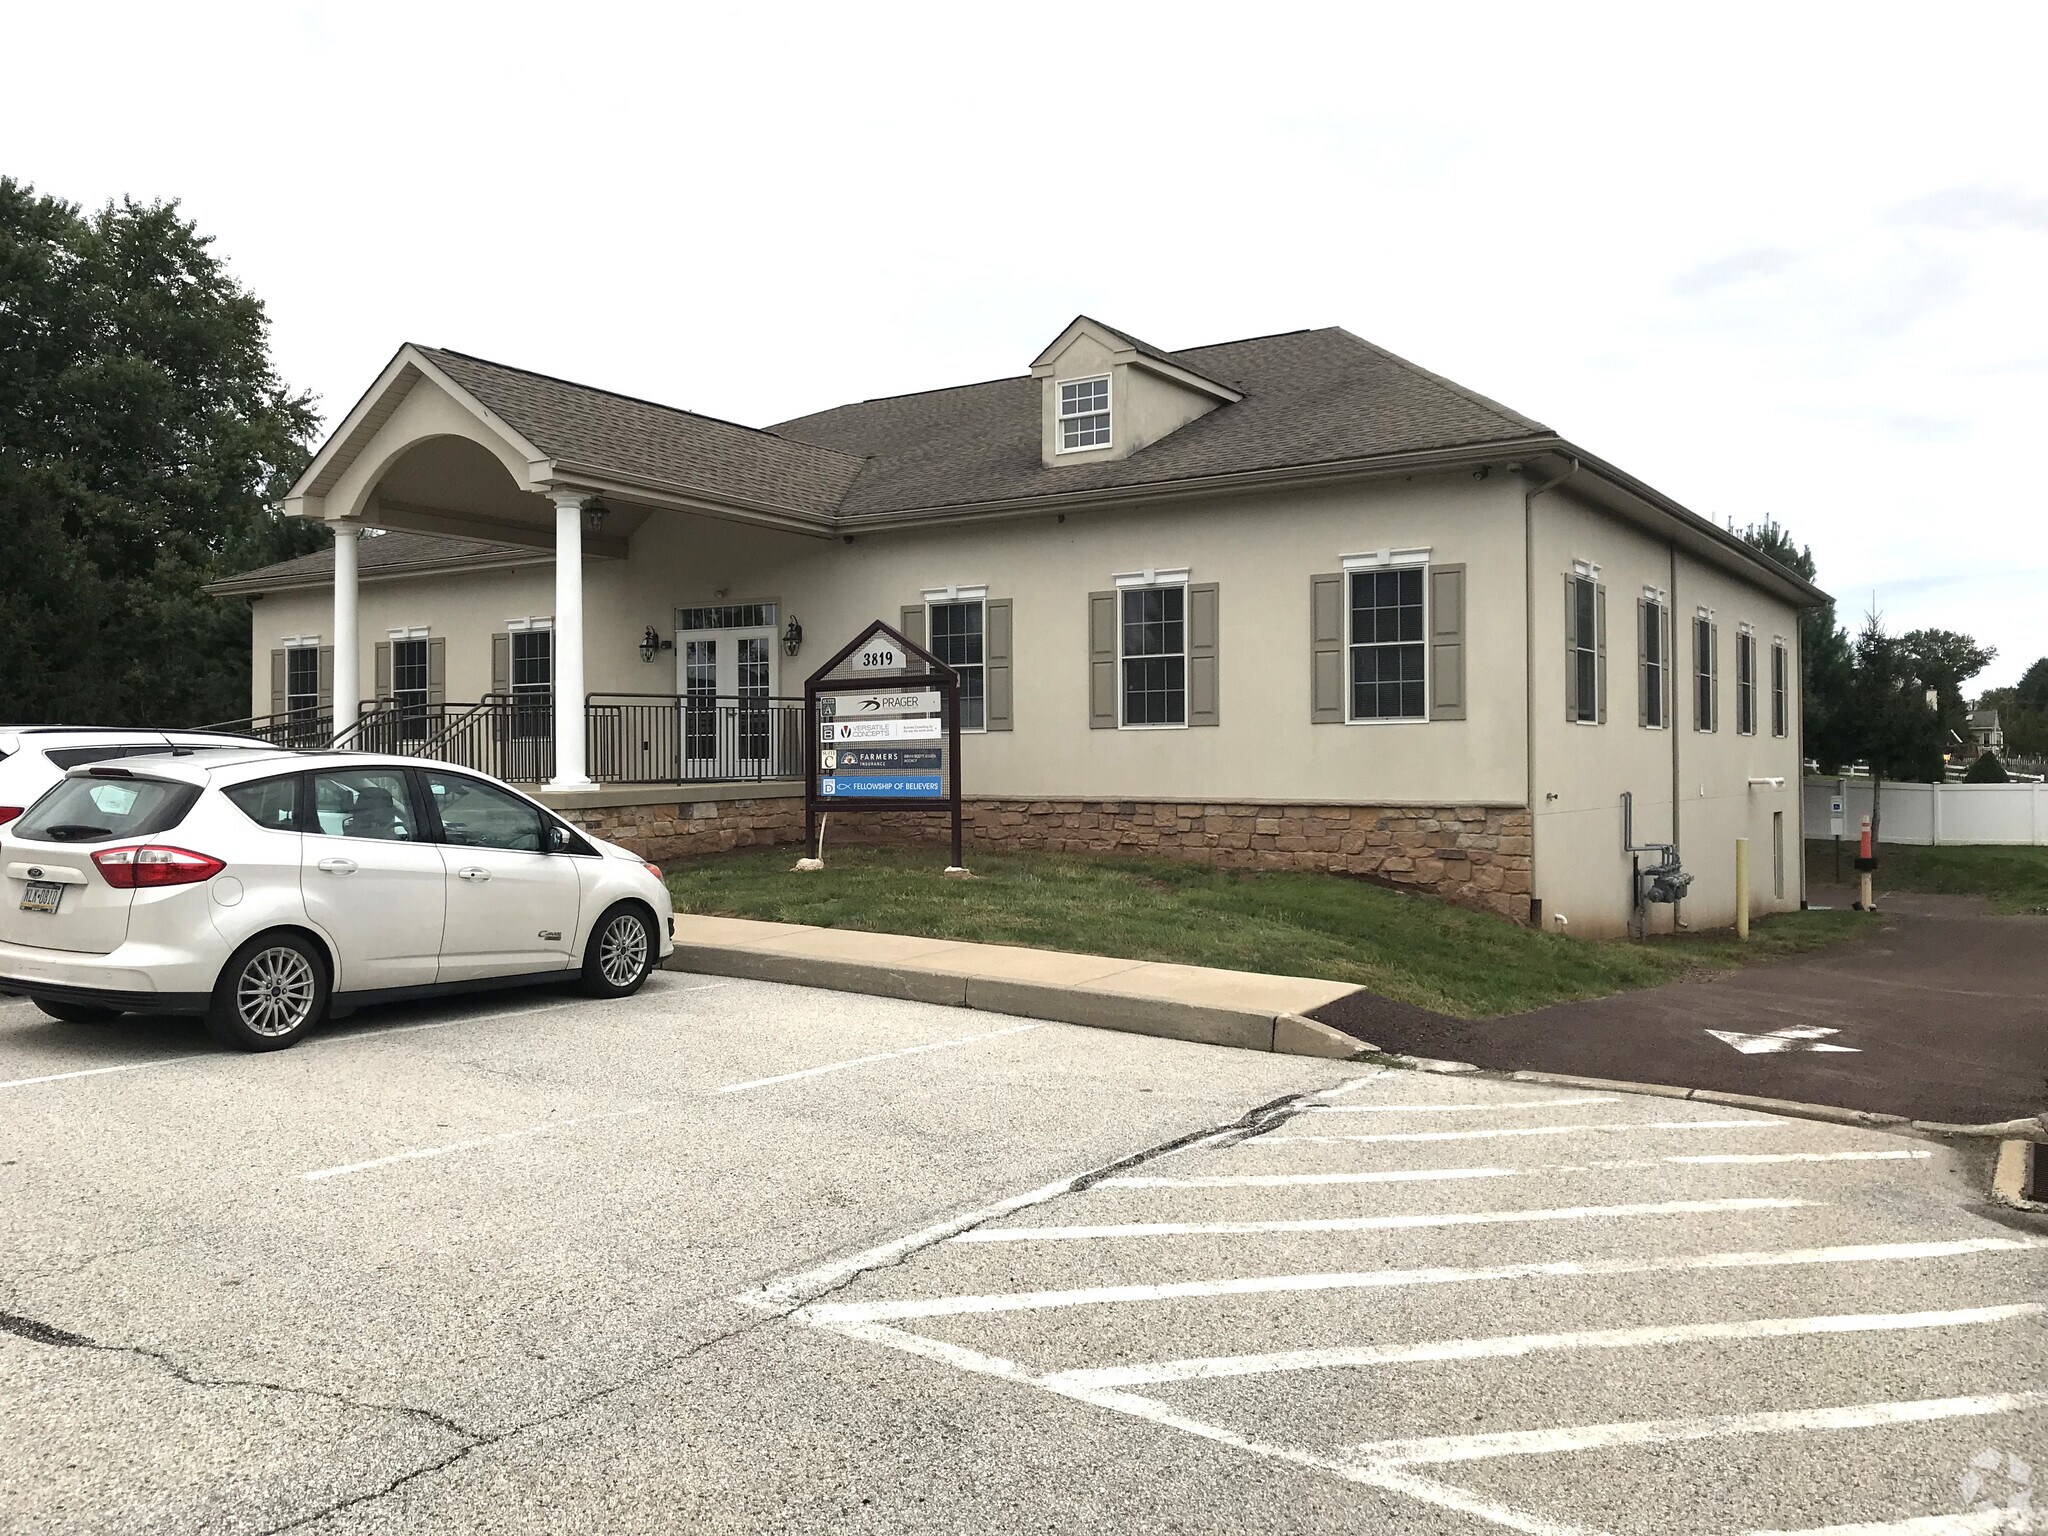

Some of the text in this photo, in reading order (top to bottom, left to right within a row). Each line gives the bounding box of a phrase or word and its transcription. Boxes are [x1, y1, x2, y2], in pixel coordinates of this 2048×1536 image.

[863, 651, 893, 667] 3819
[882, 697, 919, 708] PRAGER
[853, 723, 890, 731] VERSATILE
[824, 730, 832, 739] B
[852, 730, 890, 738] CONCEPTS
[860, 752, 898, 761] FARMERS
[824, 755, 834, 769] C
[825, 784, 834, 793] D
[853, 782, 939, 790] FELLOWSHIP OF BELIEVERS
